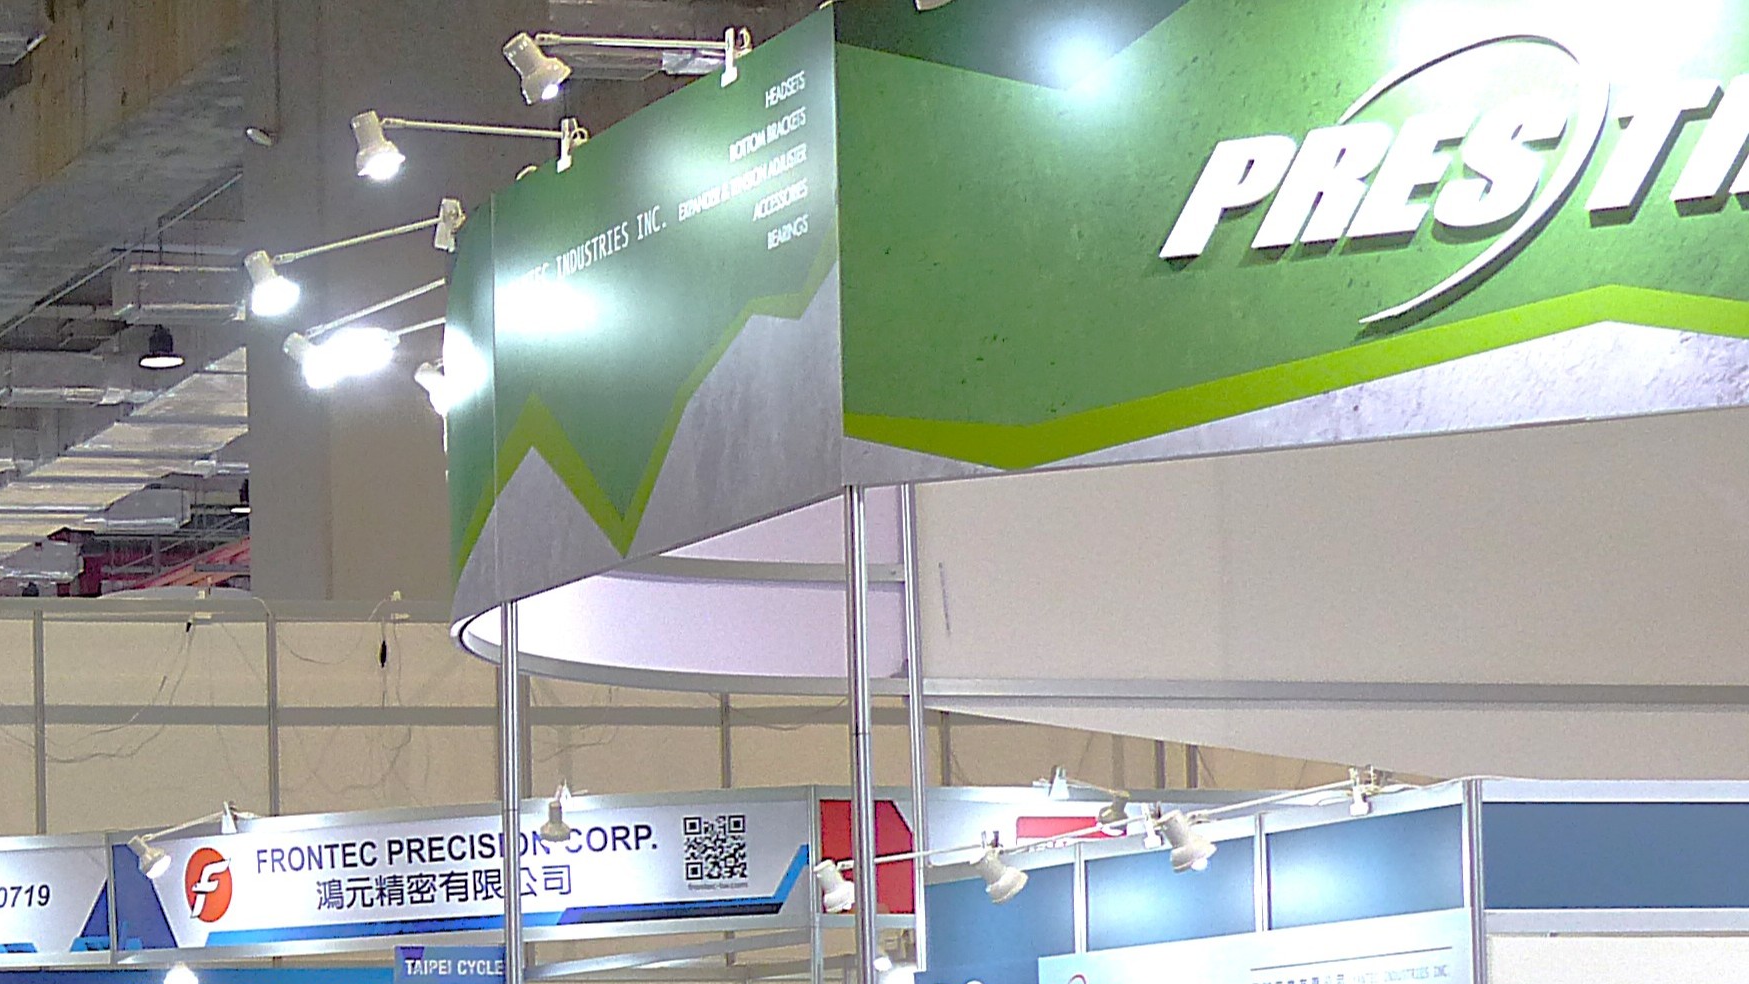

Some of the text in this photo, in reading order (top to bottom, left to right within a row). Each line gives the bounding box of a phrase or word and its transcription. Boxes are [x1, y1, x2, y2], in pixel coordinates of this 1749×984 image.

[1159, 72, 1749, 260] PRESTI
[555, 221, 628, 279] INDUSTRIES
[636, 205, 667, 240] INC.
[256, 840, 377, 874] FRONTEC
[564, 824, 658, 854] CORP.
[317, 864, 572, 910] 鴻元精密有限公司
[405, 959, 505, 976] TAIPEI CYCLE
